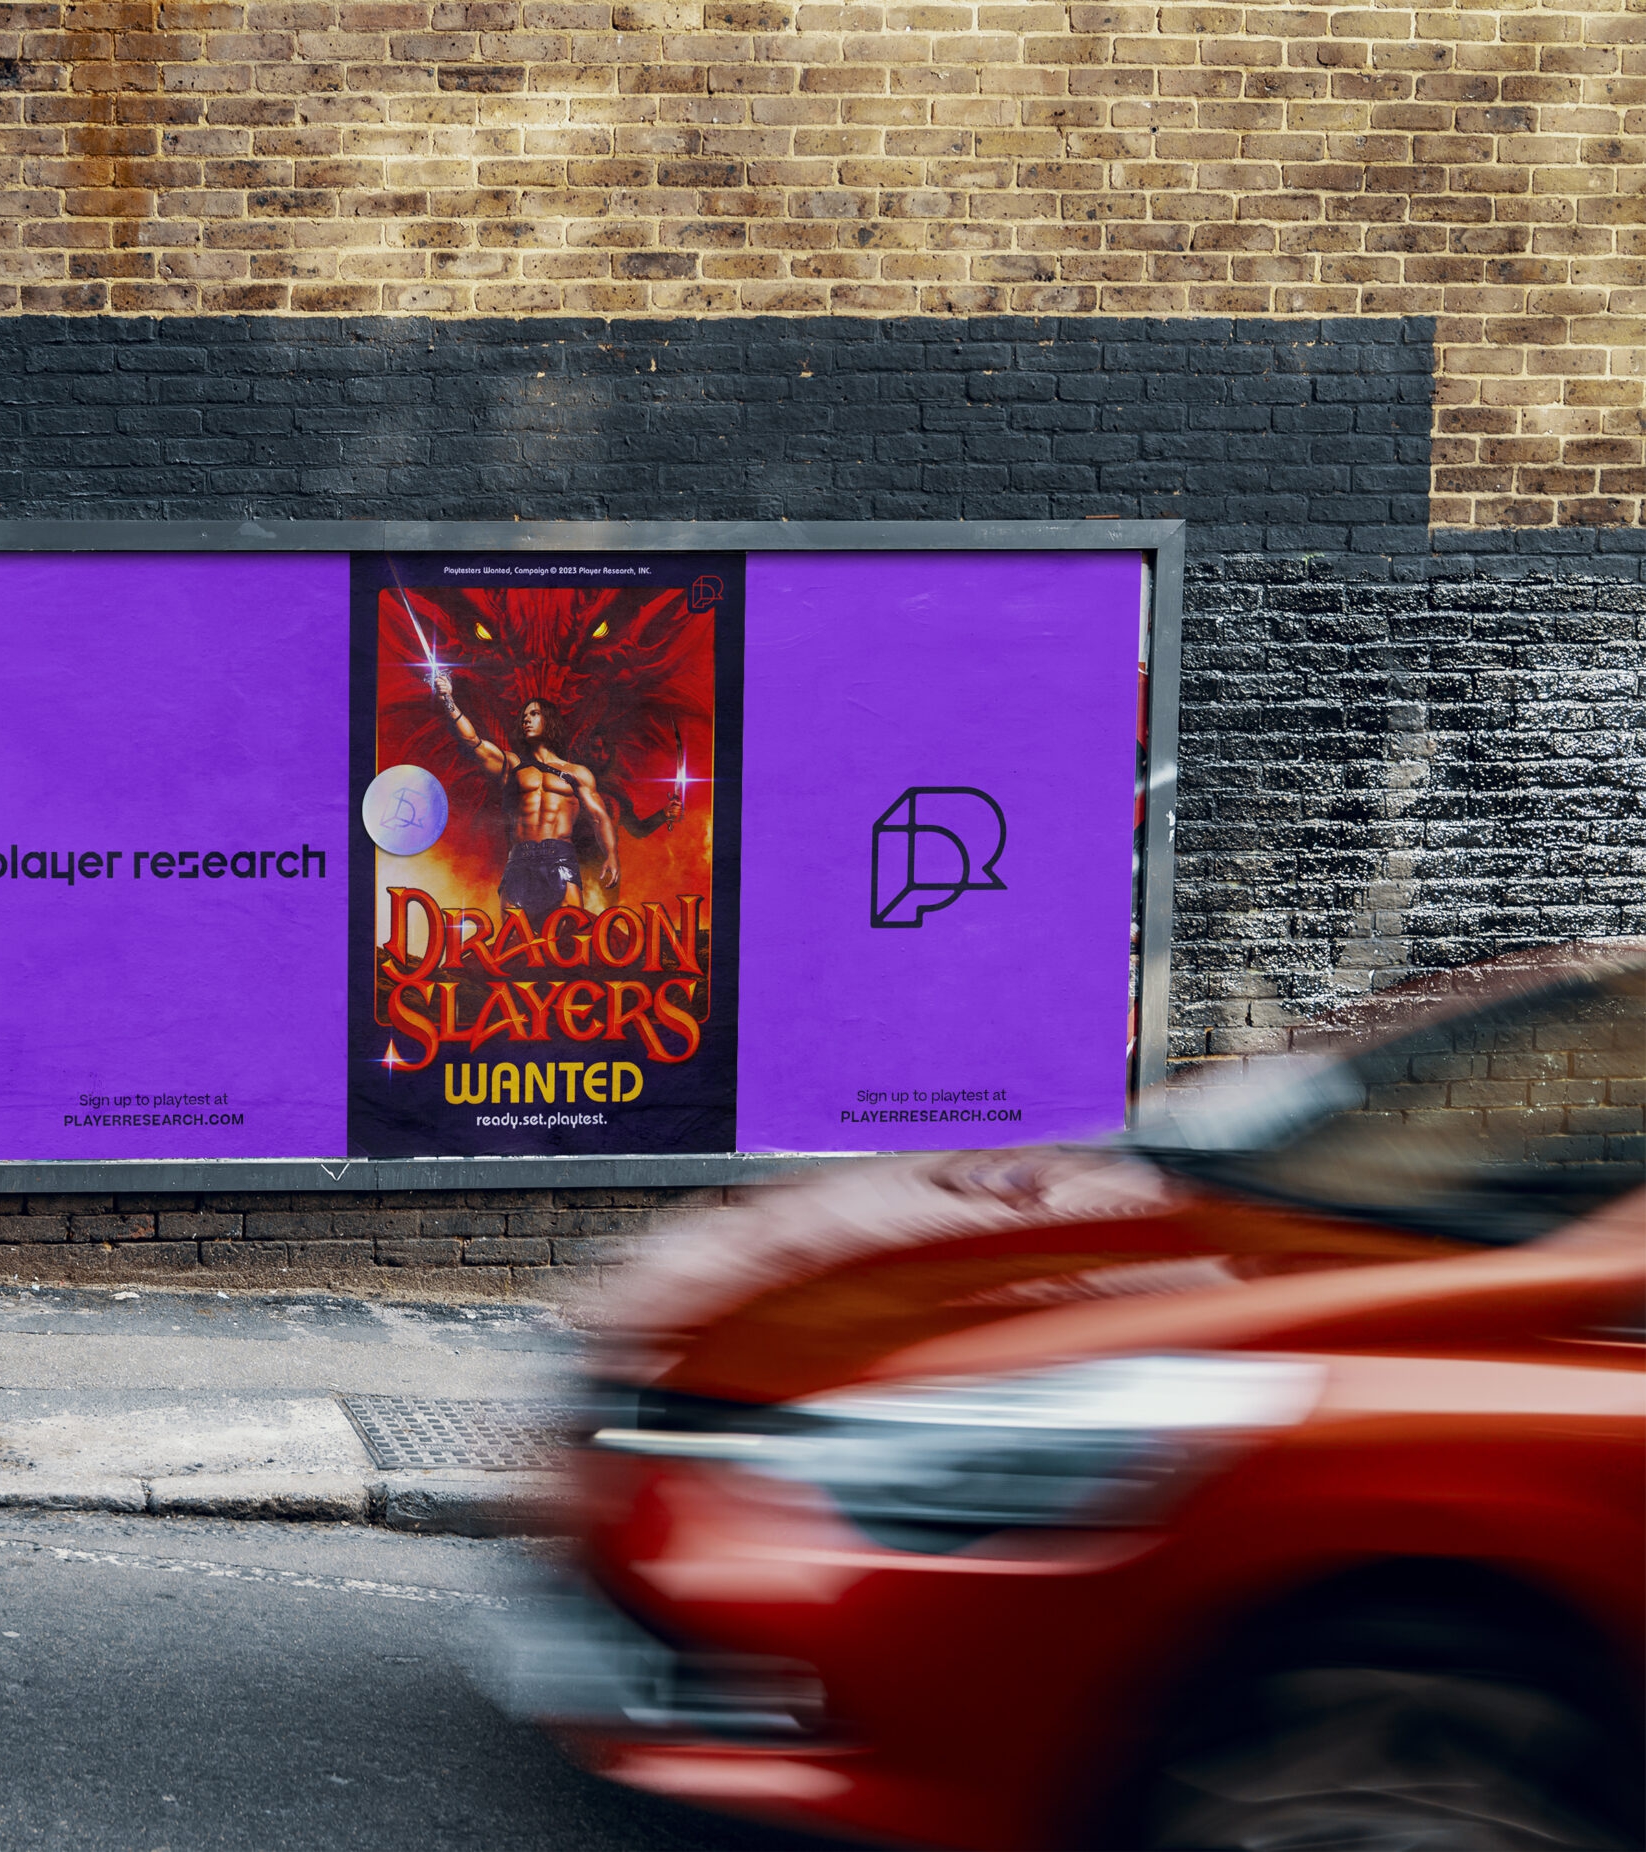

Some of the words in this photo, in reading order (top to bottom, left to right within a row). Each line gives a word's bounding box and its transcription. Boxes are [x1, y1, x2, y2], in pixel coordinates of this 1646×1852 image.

[443, 566, 481, 575] Playtesters
[483, 566, 513, 575] Wanted,
[514, 566, 549, 575] Campaign
[558, 566, 577, 574] 2023
[579, 566, 601, 575] Player
[603, 566, 636, 575] Research,
[638, 566, 652, 574] INC.
[134, 844, 326, 879] research
[381, 886, 705, 982] DRAGON
[381, 979, 701, 1071] SLAYERS
[444, 1061, 644, 1105] WANTED
[79, 1094, 110, 1110] Sign
[114, 1096, 132, 1108] up
[135, 1093, 150, 1106] to
[153, 1093, 210, 1109] playtest
[214, 1093, 228, 1105] at
[857, 1089, 888, 1106] Sign
[891, 1092, 910, 1105] up
[913, 1090, 928, 1102] to
[931, 1088, 990, 1105] playtest
[992, 1089, 1007, 1101] at
[64, 1113, 244, 1127] PLAYERRESEARCH.COM
[476, 1112, 607, 1129] ready.set.playtest.
[841, 1110, 1022, 1123] PLAYERRESEARCH.COM
